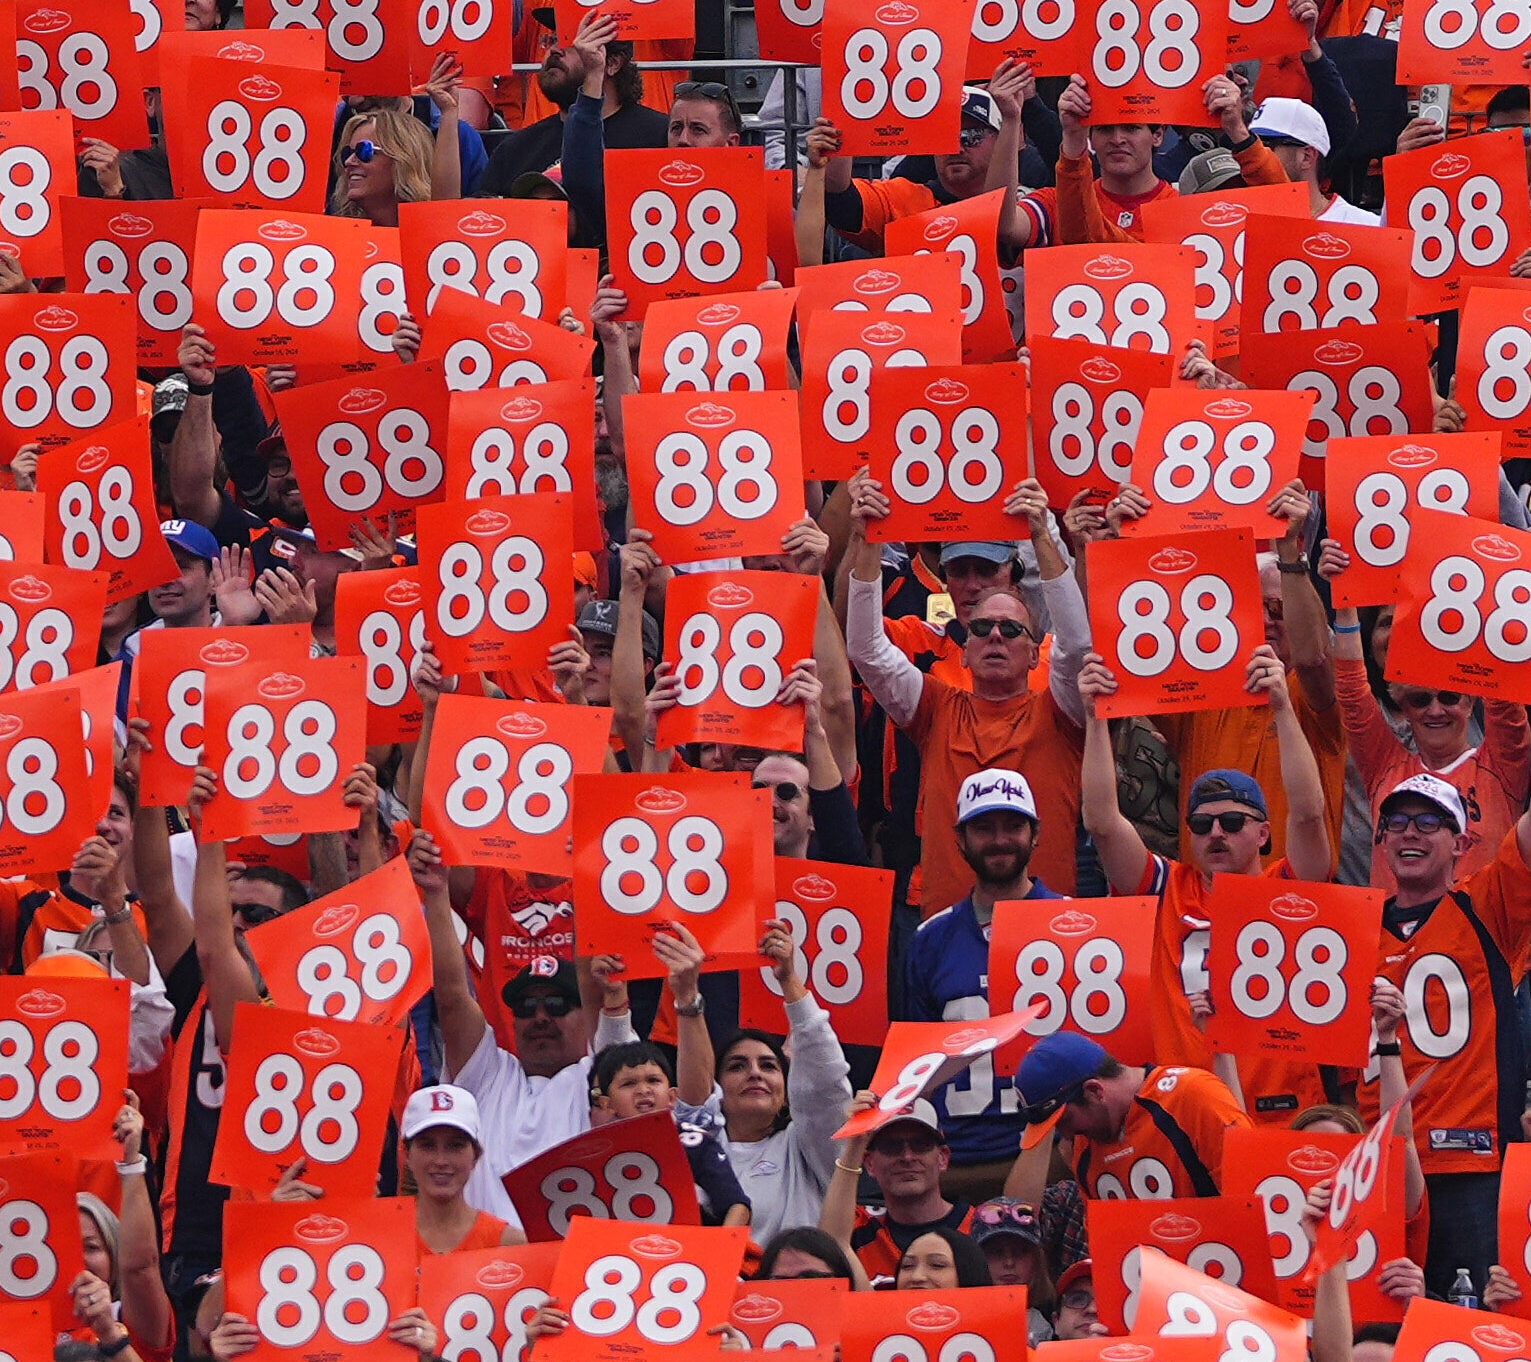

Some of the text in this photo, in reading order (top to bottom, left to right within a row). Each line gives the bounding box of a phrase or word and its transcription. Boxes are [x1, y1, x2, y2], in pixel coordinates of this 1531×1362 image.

[1153, 420, 1275, 505] 88
[445, 736, 572, 835] 88
[963, 779, 1027, 801] New York
[1231, 921, 1347, 1025] 88
[256, 1244, 389, 1347] 88
